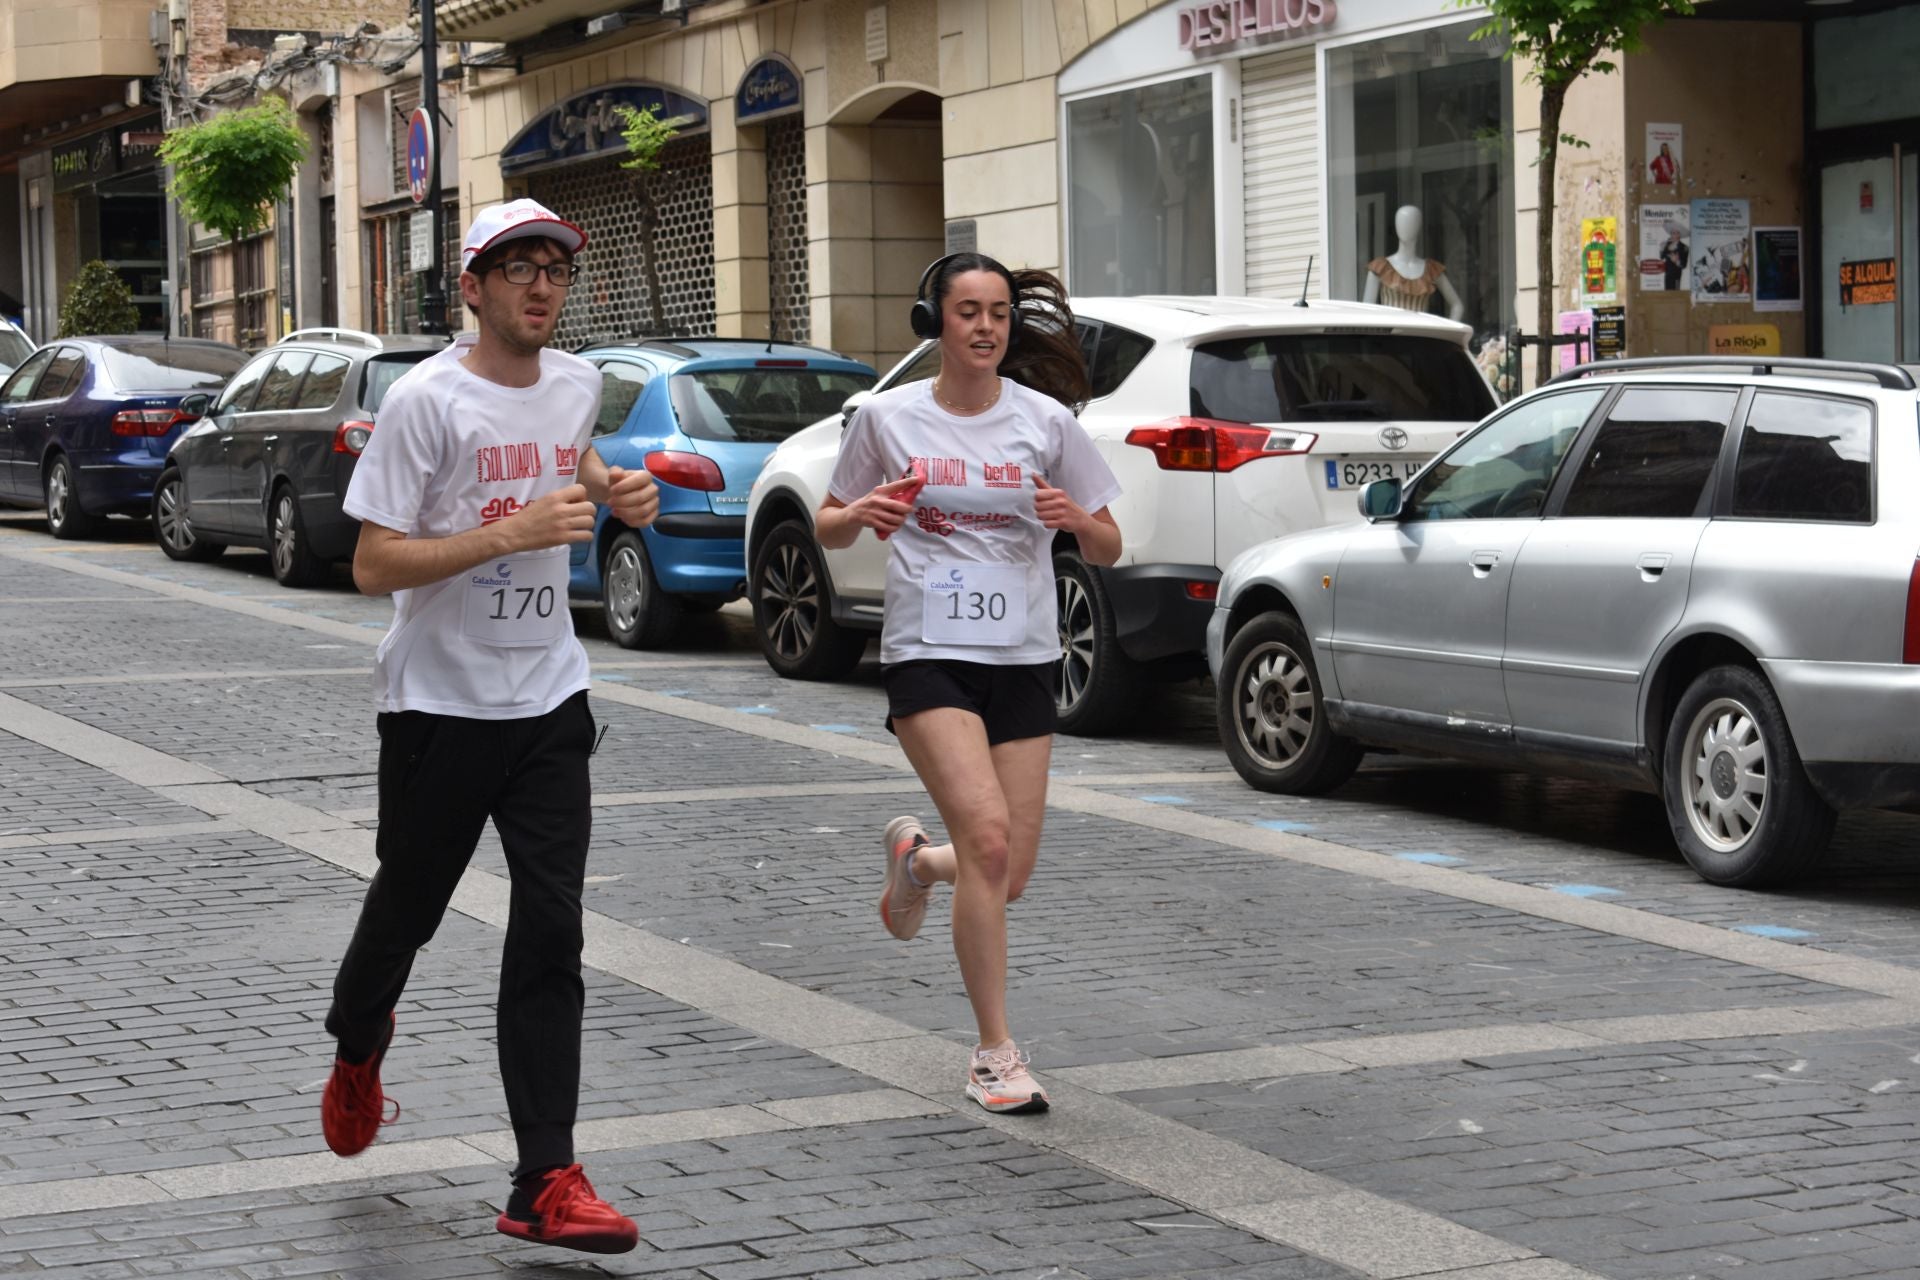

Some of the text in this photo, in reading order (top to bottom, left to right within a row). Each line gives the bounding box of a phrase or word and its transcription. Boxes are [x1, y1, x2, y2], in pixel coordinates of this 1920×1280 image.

[1178, 0, 1324, 51] DESTELLOS
[1840, 260, 1895, 285] SE ALQUILA
[1715, 335, 1766, 349] La Rioja
[483, 442, 542, 482] SOLIDARIA
[984, 462, 1021, 481] berlin
[1344, 463, 1394, 485] 6233
[472, 576, 511, 585] Calahorra
[489, 586, 554, 619] 170
[947, 592, 1006, 621] 130
